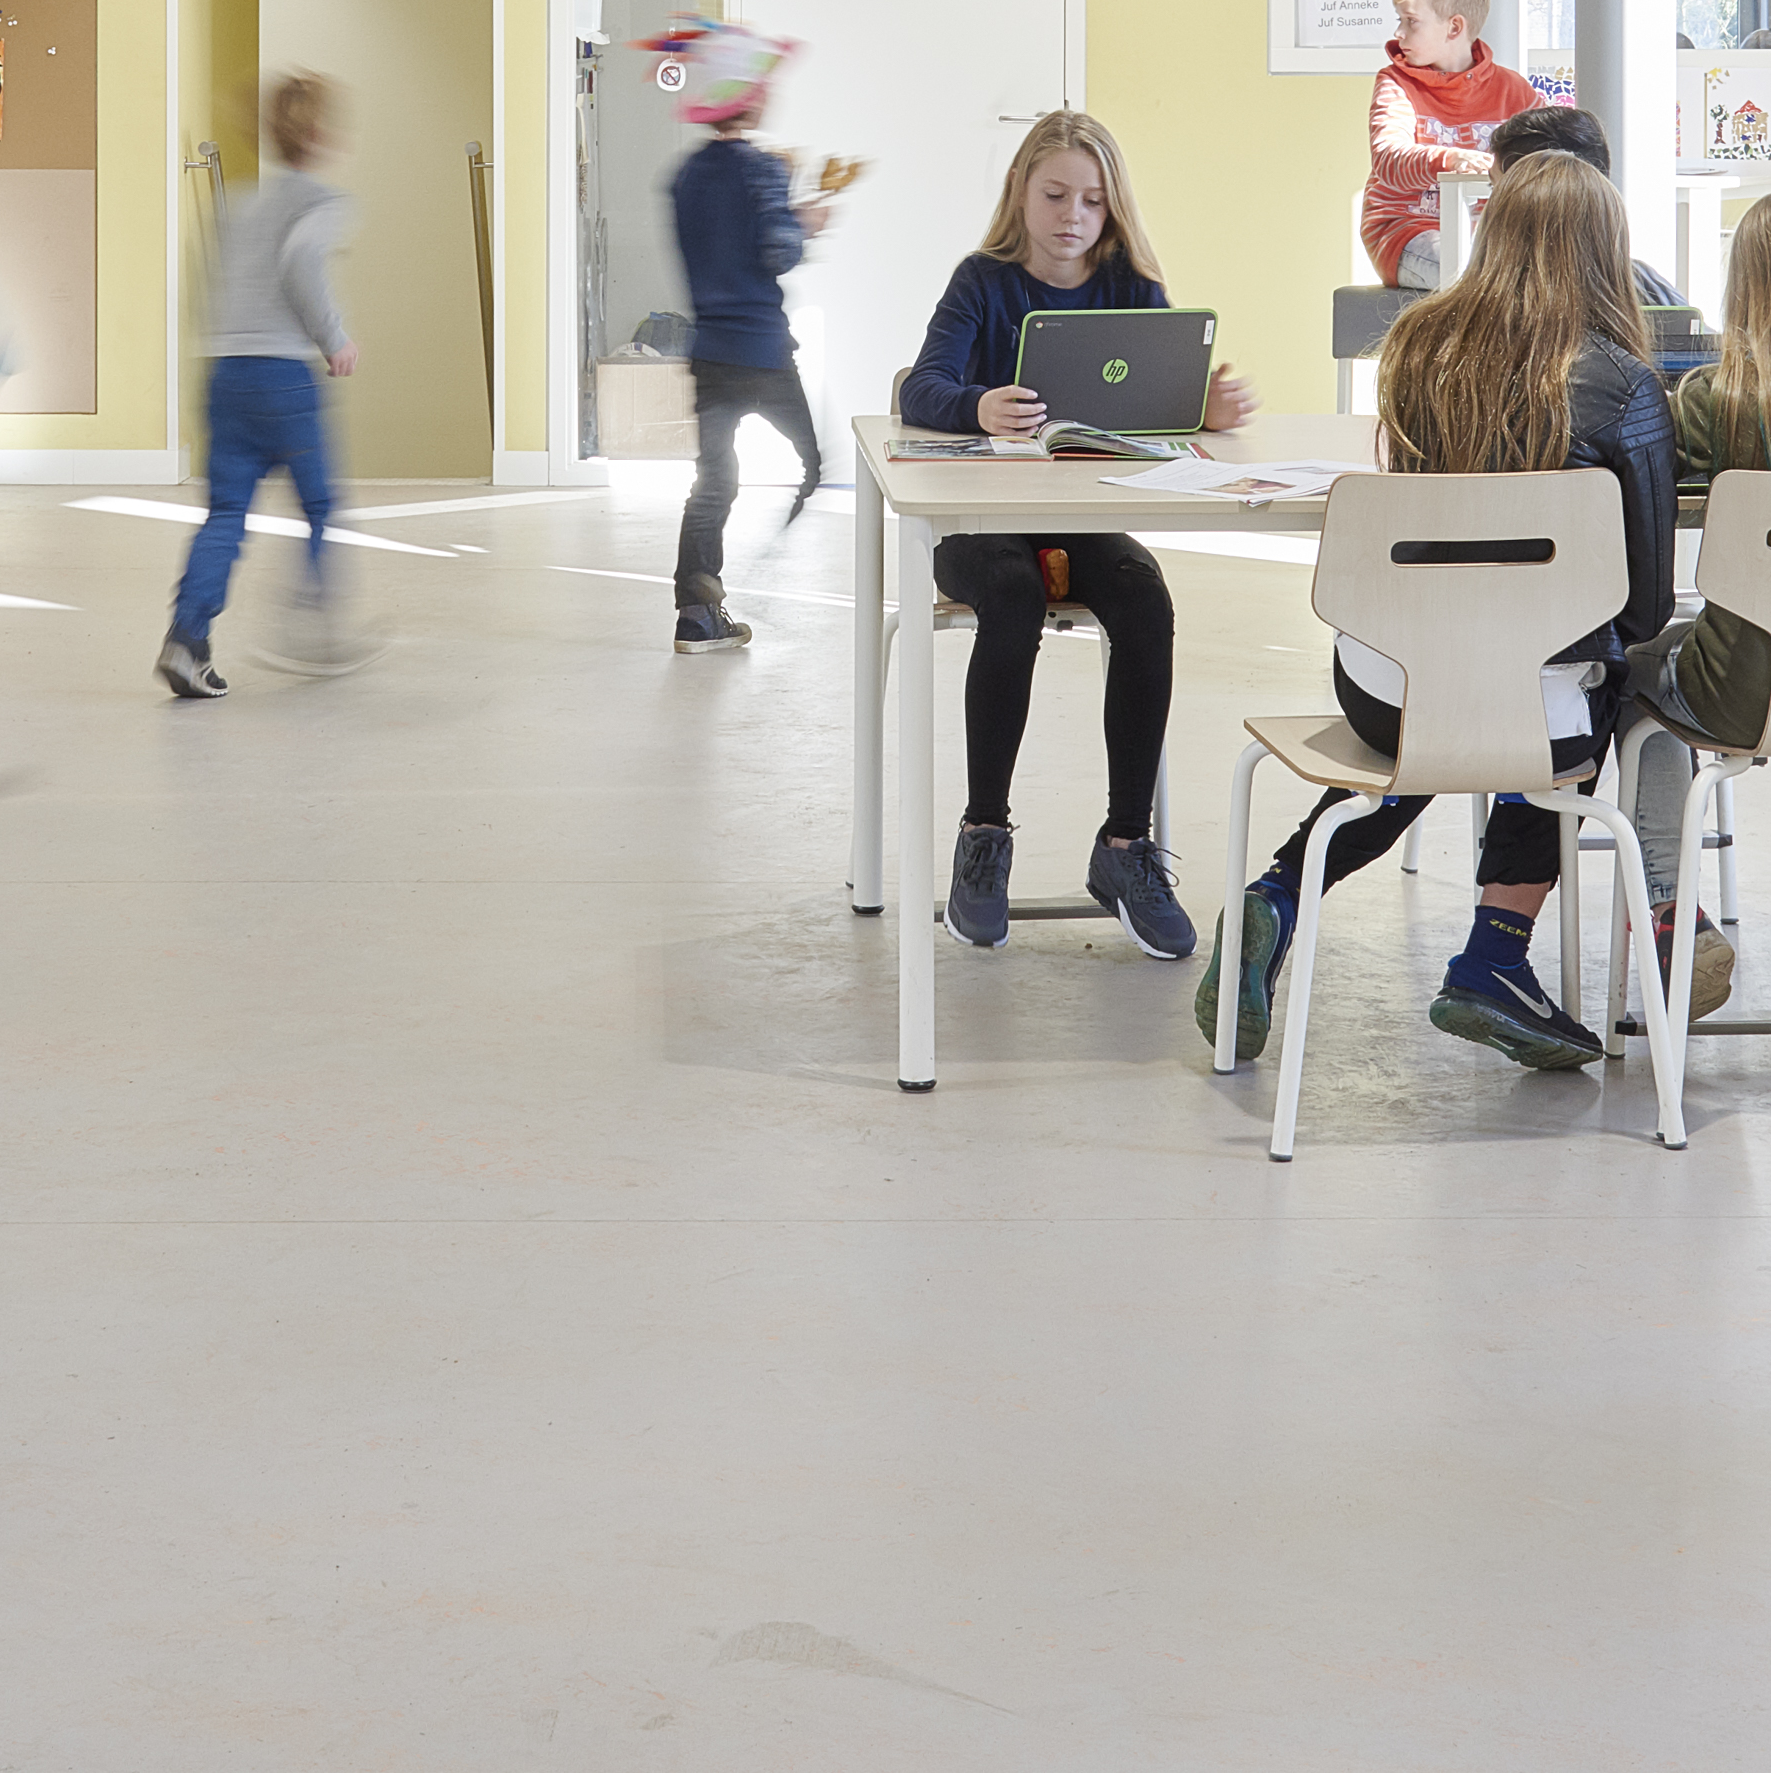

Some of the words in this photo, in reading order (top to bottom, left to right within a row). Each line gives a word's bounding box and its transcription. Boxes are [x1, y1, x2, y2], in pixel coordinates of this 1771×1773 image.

[1320, 1, 1337, 11] Juf
[1338, 0, 1379, 10] Anneke
[1317, 17, 1334, 28] Juf
[1336, 16, 1383, 27] Susanne
[1104, 359, 1127, 384] hp
[1489, 918, 1527, 937] ZEEM
